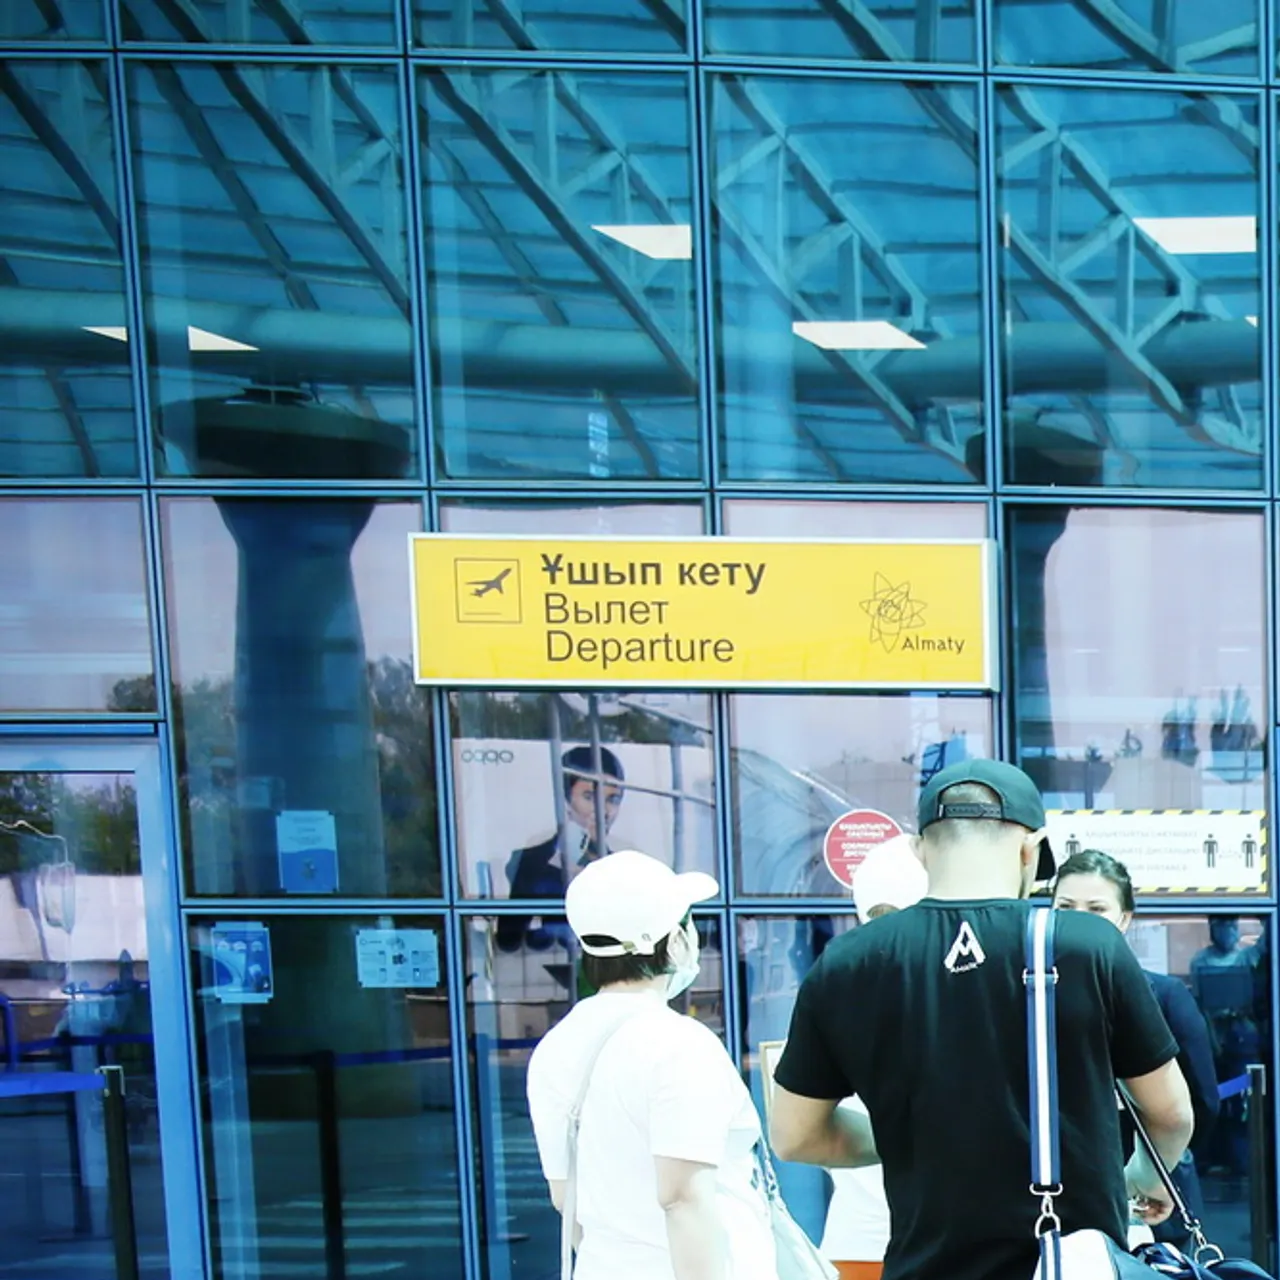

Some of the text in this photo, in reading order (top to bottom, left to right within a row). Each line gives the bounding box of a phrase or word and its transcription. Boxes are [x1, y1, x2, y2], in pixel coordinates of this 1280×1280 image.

[540, 553, 767, 595] Ұшып кету
[544, 592, 670, 625] Вылет
[546, 629, 735, 670] Departure
[901, 634, 966, 655] Almaty
